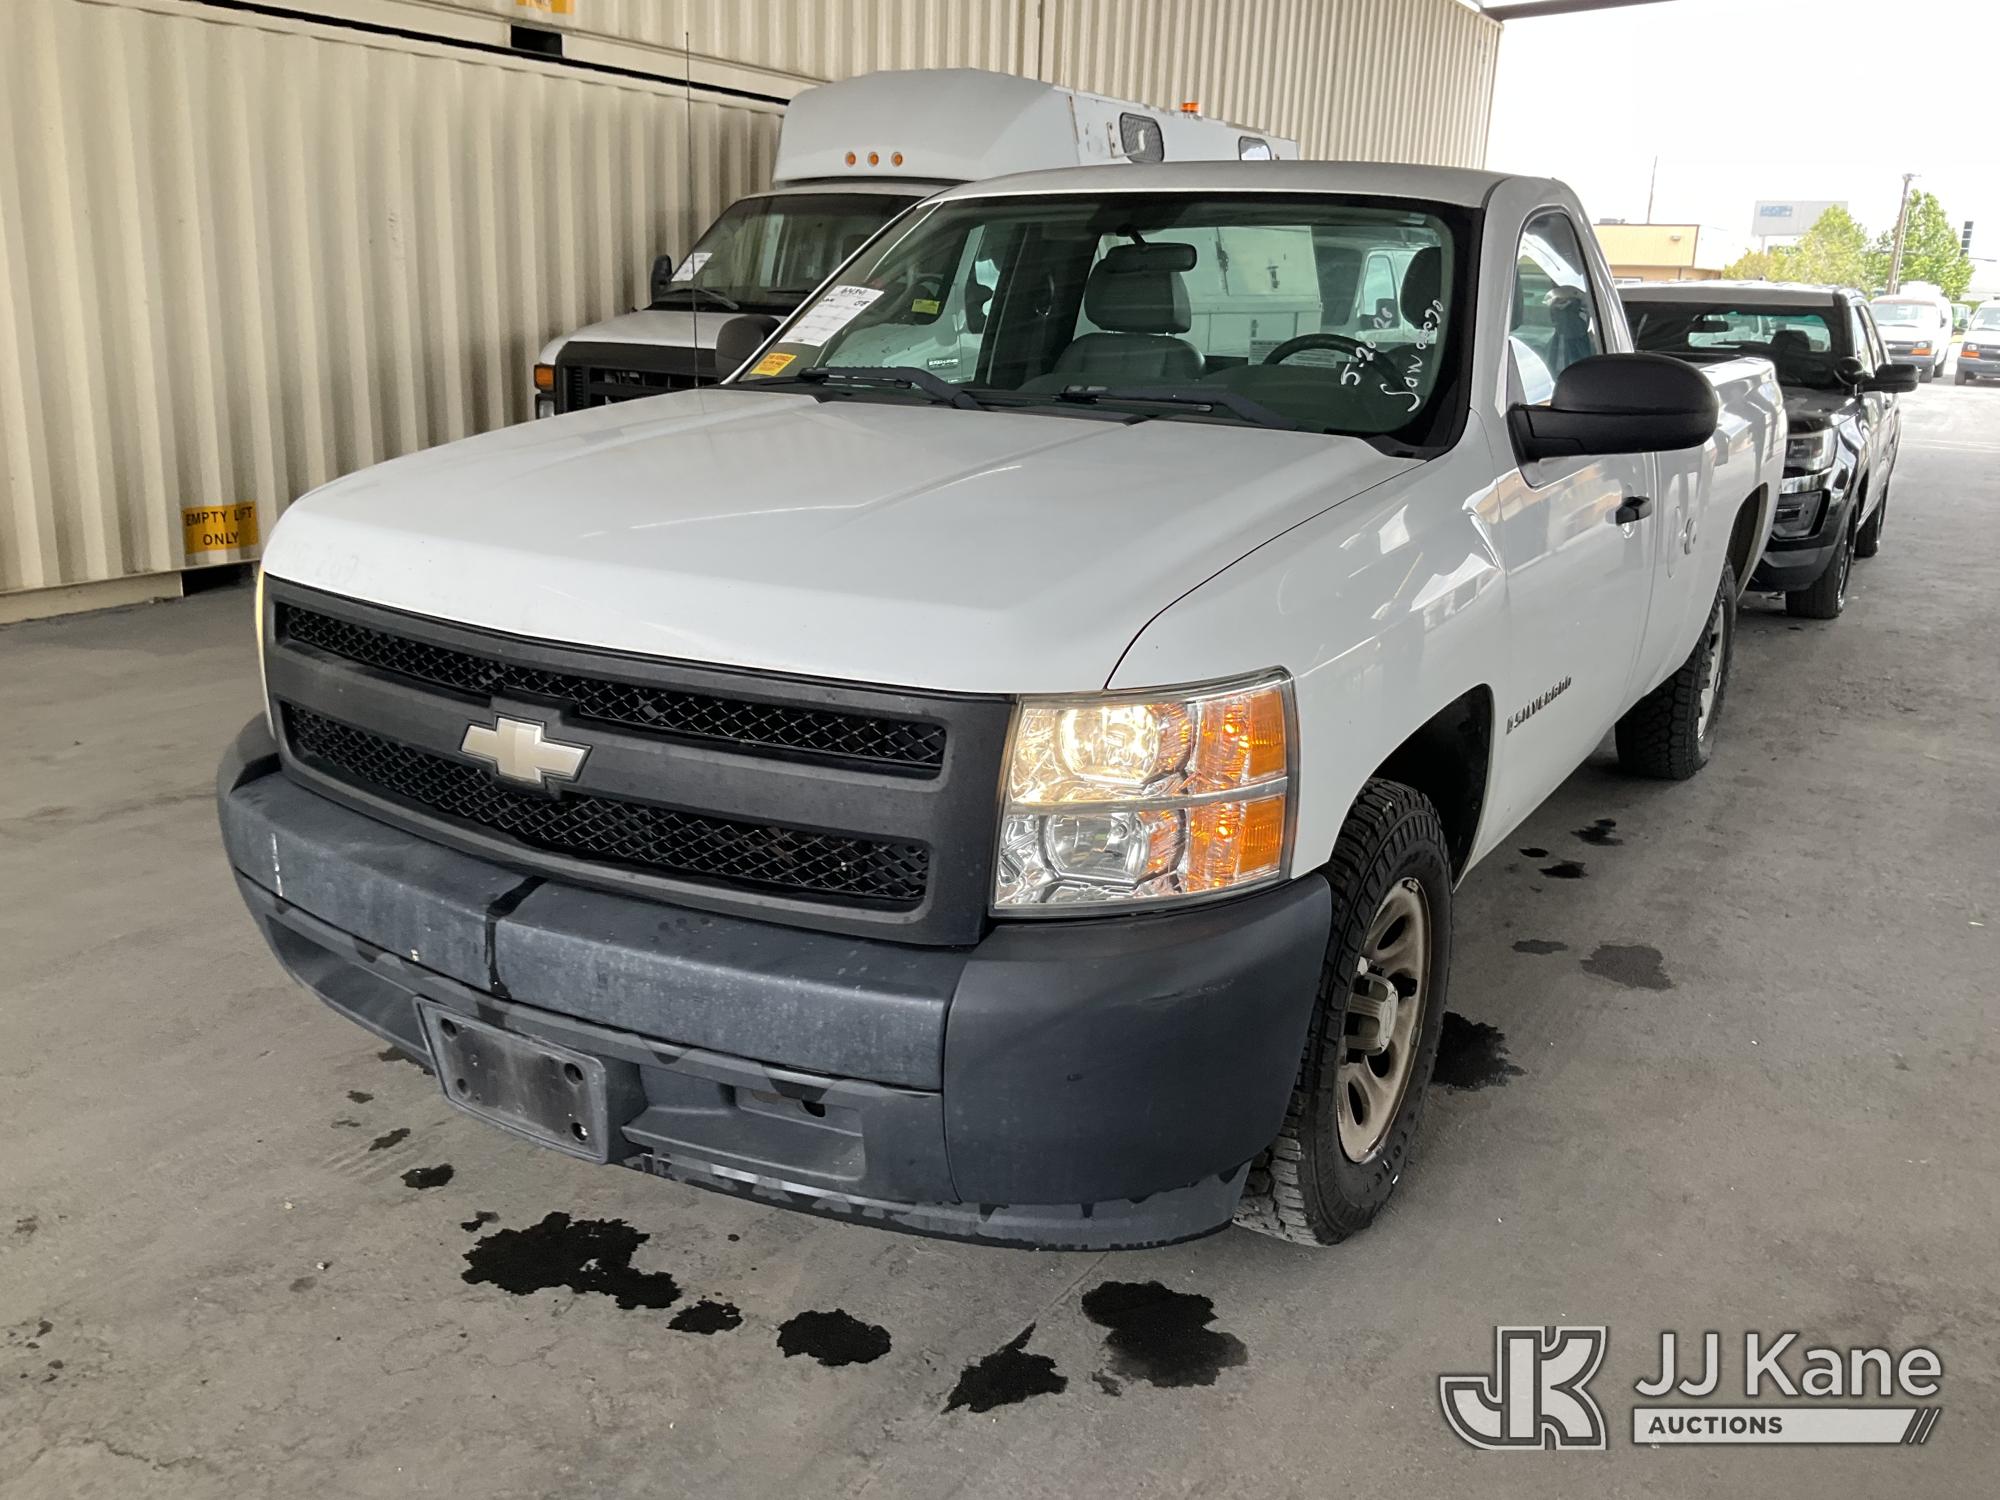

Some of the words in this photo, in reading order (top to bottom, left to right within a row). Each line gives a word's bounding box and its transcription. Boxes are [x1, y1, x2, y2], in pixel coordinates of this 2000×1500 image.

[185, 510, 228, 527] EMPTY
[233, 506, 253, 522] LFT
[202, 531, 240, 546] ONLY
